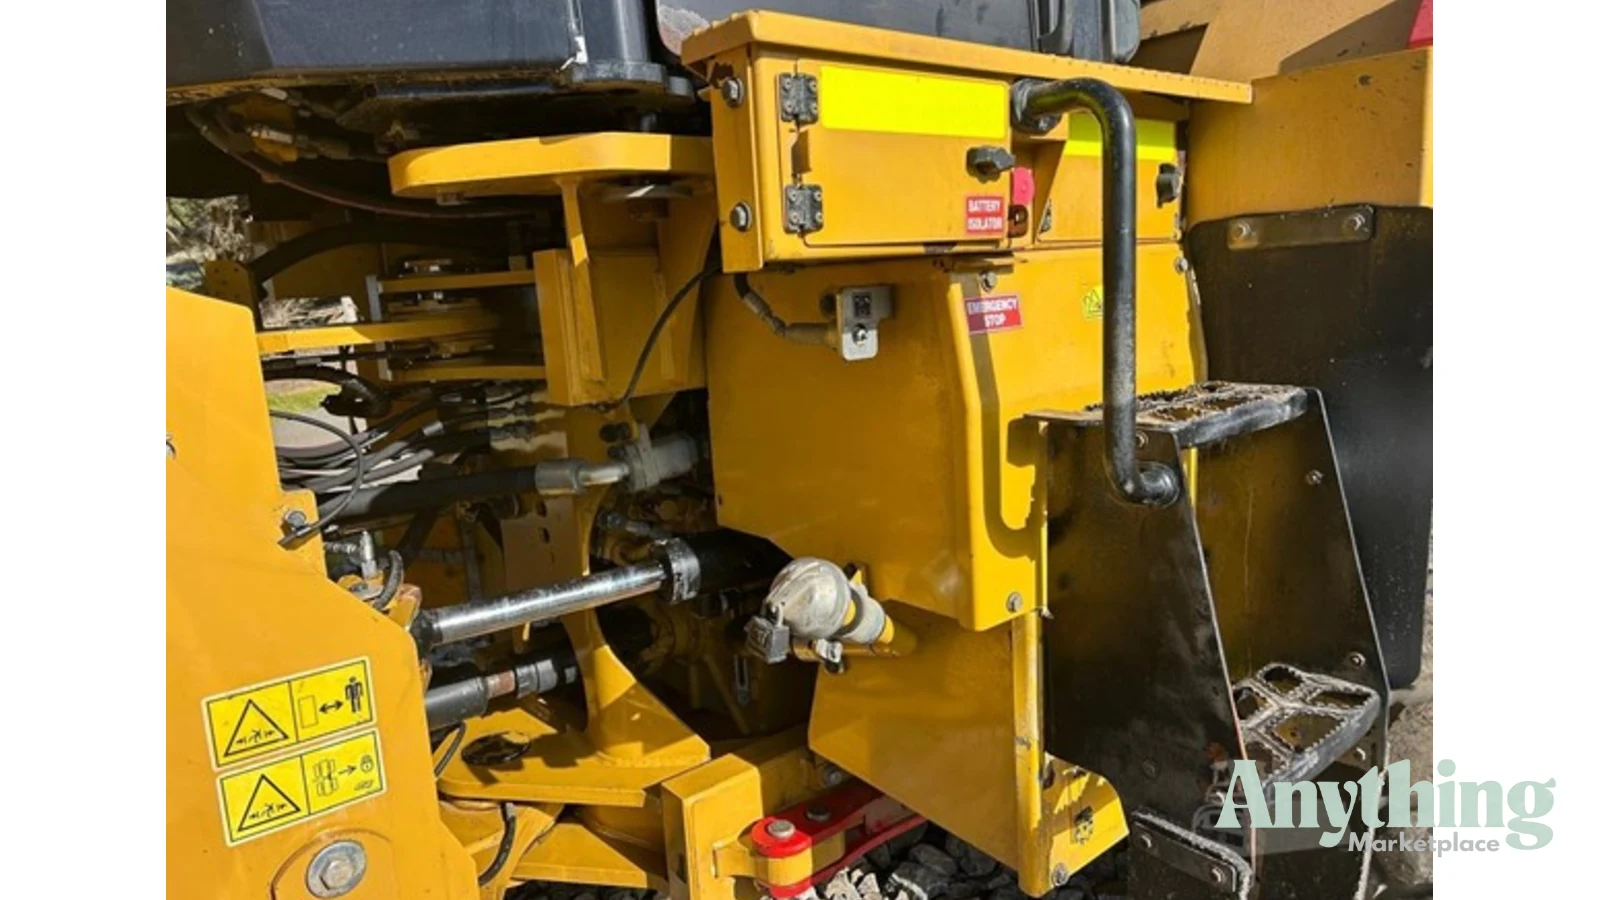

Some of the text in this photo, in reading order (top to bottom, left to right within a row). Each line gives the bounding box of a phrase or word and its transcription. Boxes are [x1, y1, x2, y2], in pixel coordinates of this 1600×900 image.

[968, 199, 1001, 212] BATTERY
[968, 217, 1003, 230] ISOLATOR
[966, 298, 1017, 315] EMERGENCY
[984, 312, 1006, 328] STOP
